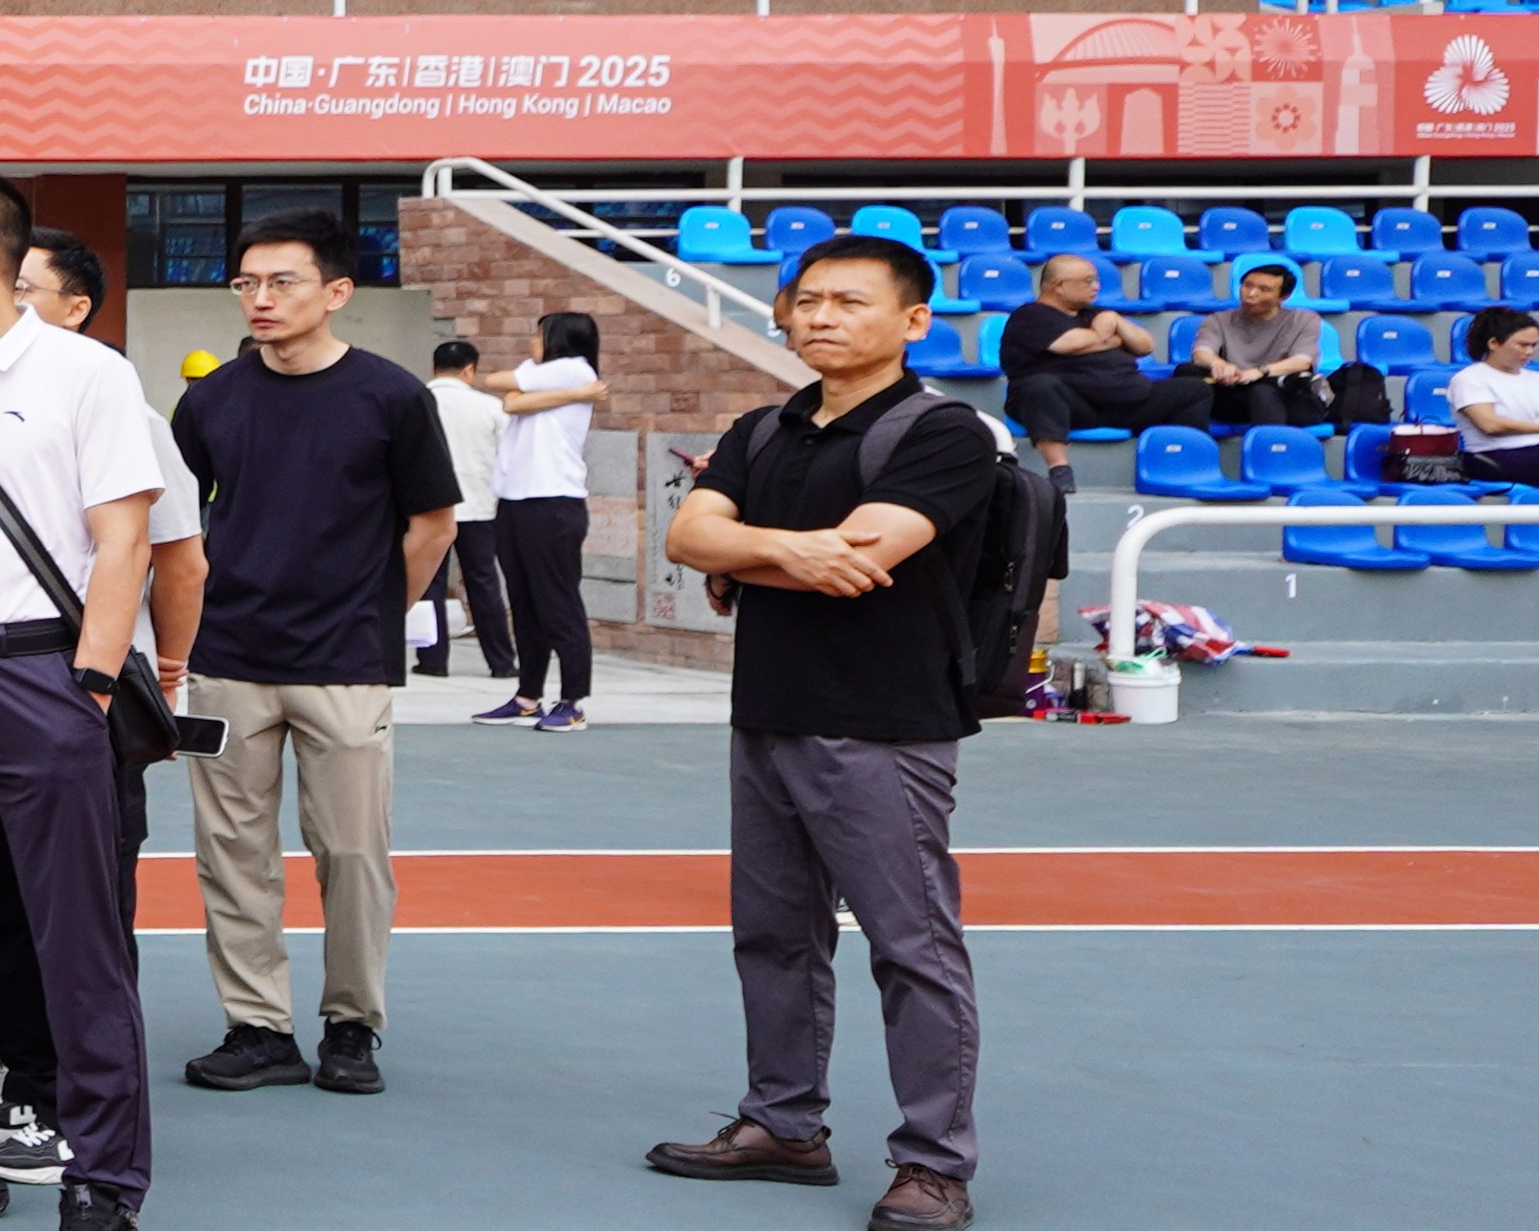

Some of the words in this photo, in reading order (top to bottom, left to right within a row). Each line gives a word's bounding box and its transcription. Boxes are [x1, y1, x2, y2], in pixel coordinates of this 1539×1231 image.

[578, 55, 671, 87] 2025
[458, 94, 517, 119] Hong
[522, 94, 579, 119] Kong
[597, 94, 671, 115] Macao
[665, 267, 681, 287] 6
[1126, 504, 1145, 529] 2
[1285, 573, 1297, 599] 1
